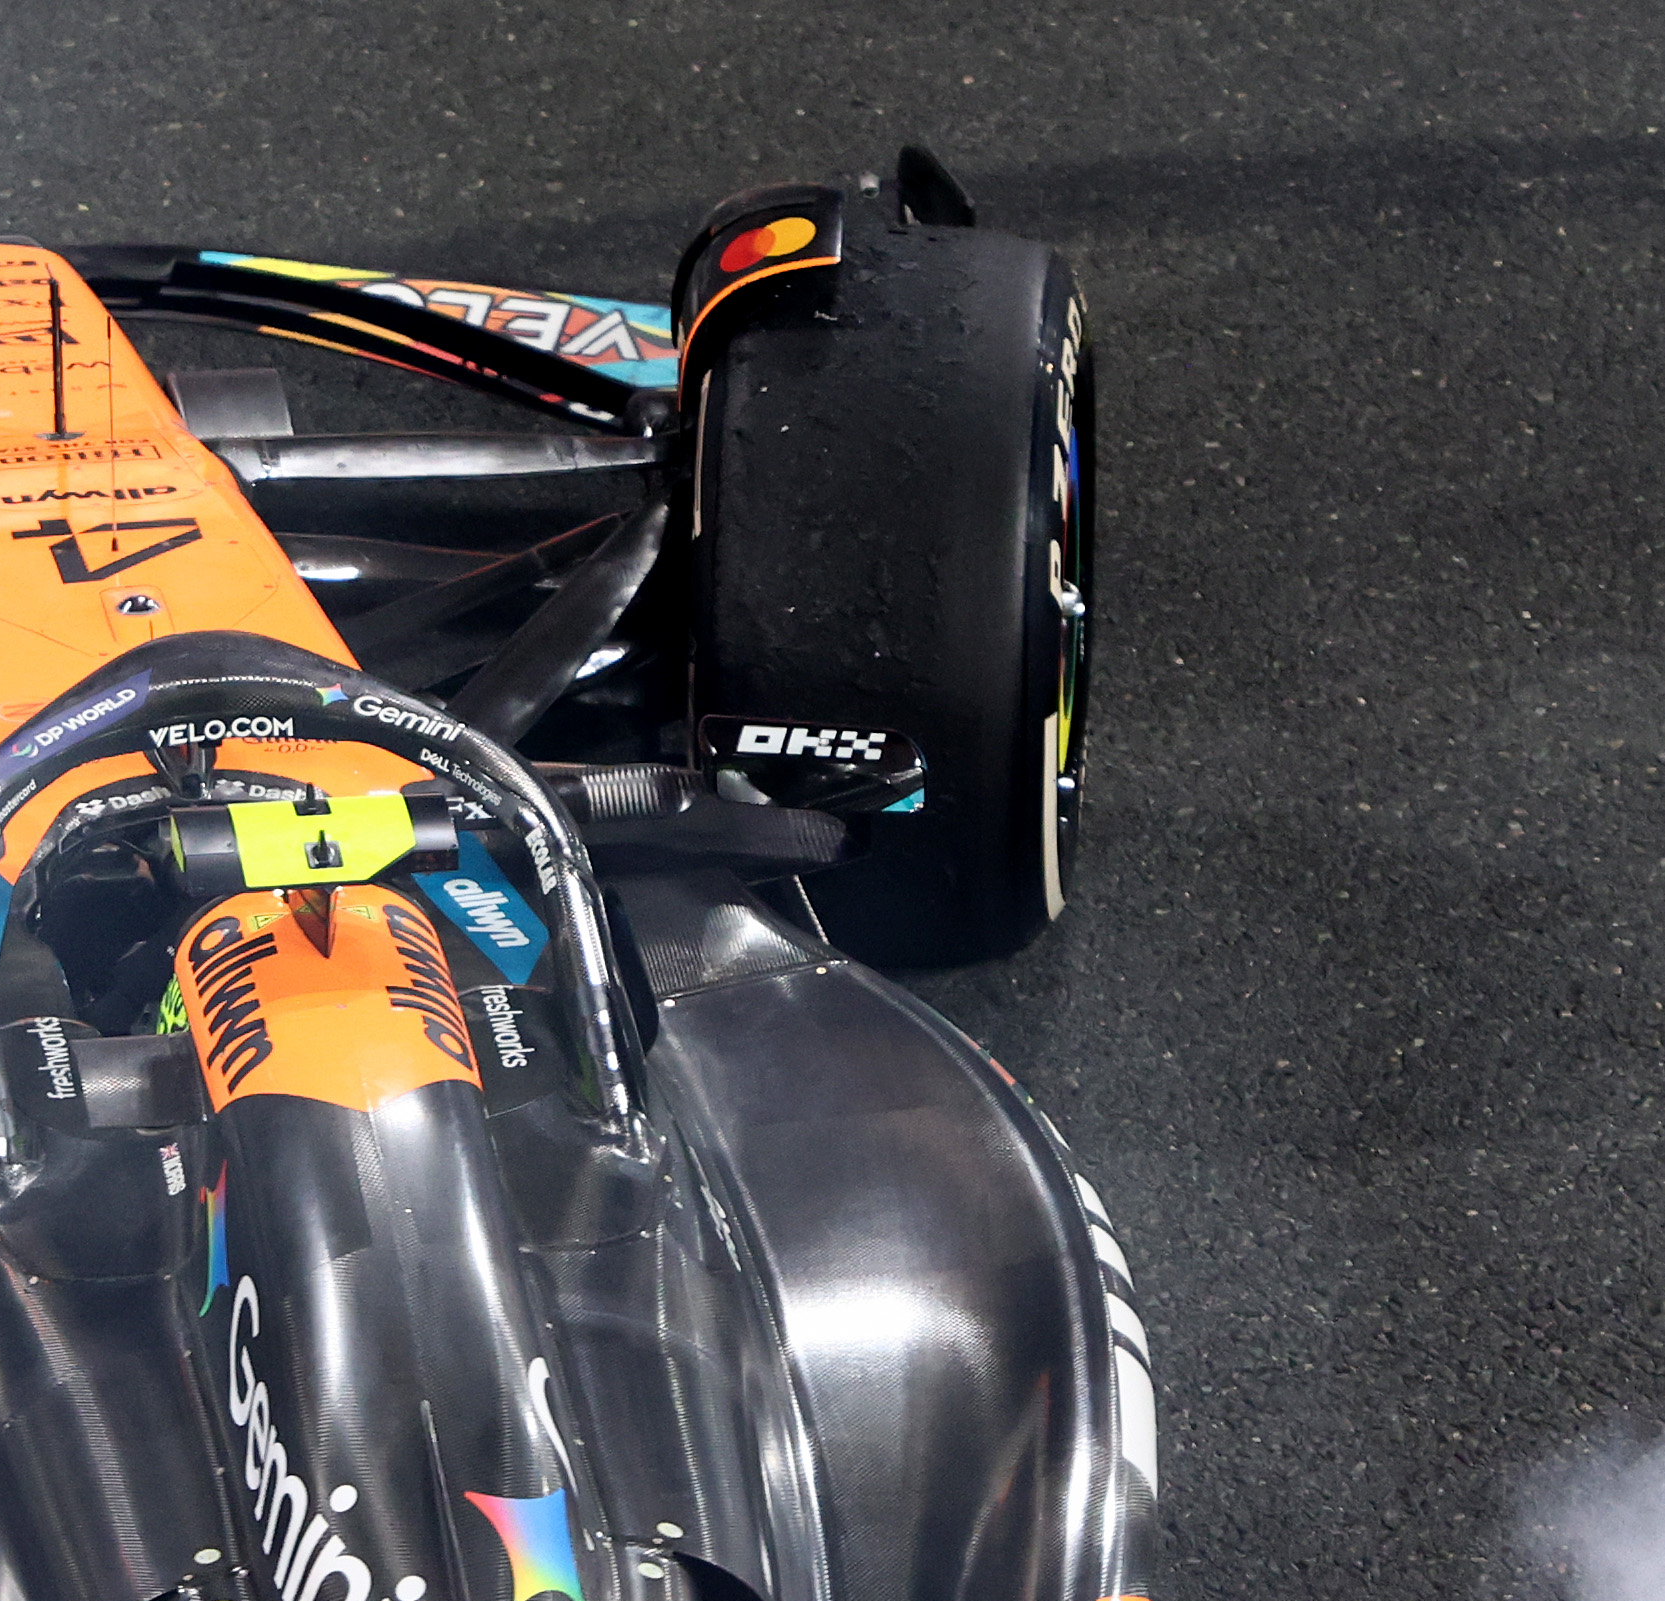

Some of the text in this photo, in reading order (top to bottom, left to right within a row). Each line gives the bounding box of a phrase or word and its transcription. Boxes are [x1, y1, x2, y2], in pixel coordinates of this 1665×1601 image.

[2, 485, 178, 504] allwyn
[11, 517, 203, 584] 4
[34, 687, 136, 746] DP WORLD
[148, 716, 294, 749] VELO.COM
[353, 695, 466, 742] Gemini
[737, 724, 886, 761] OKX
[442, 878, 530, 949] allwyn
[188, 915, 278, 1096] allwyn
[480, 984, 535, 1069] freshworks
[26, 1015, 77, 1101] freshworks
